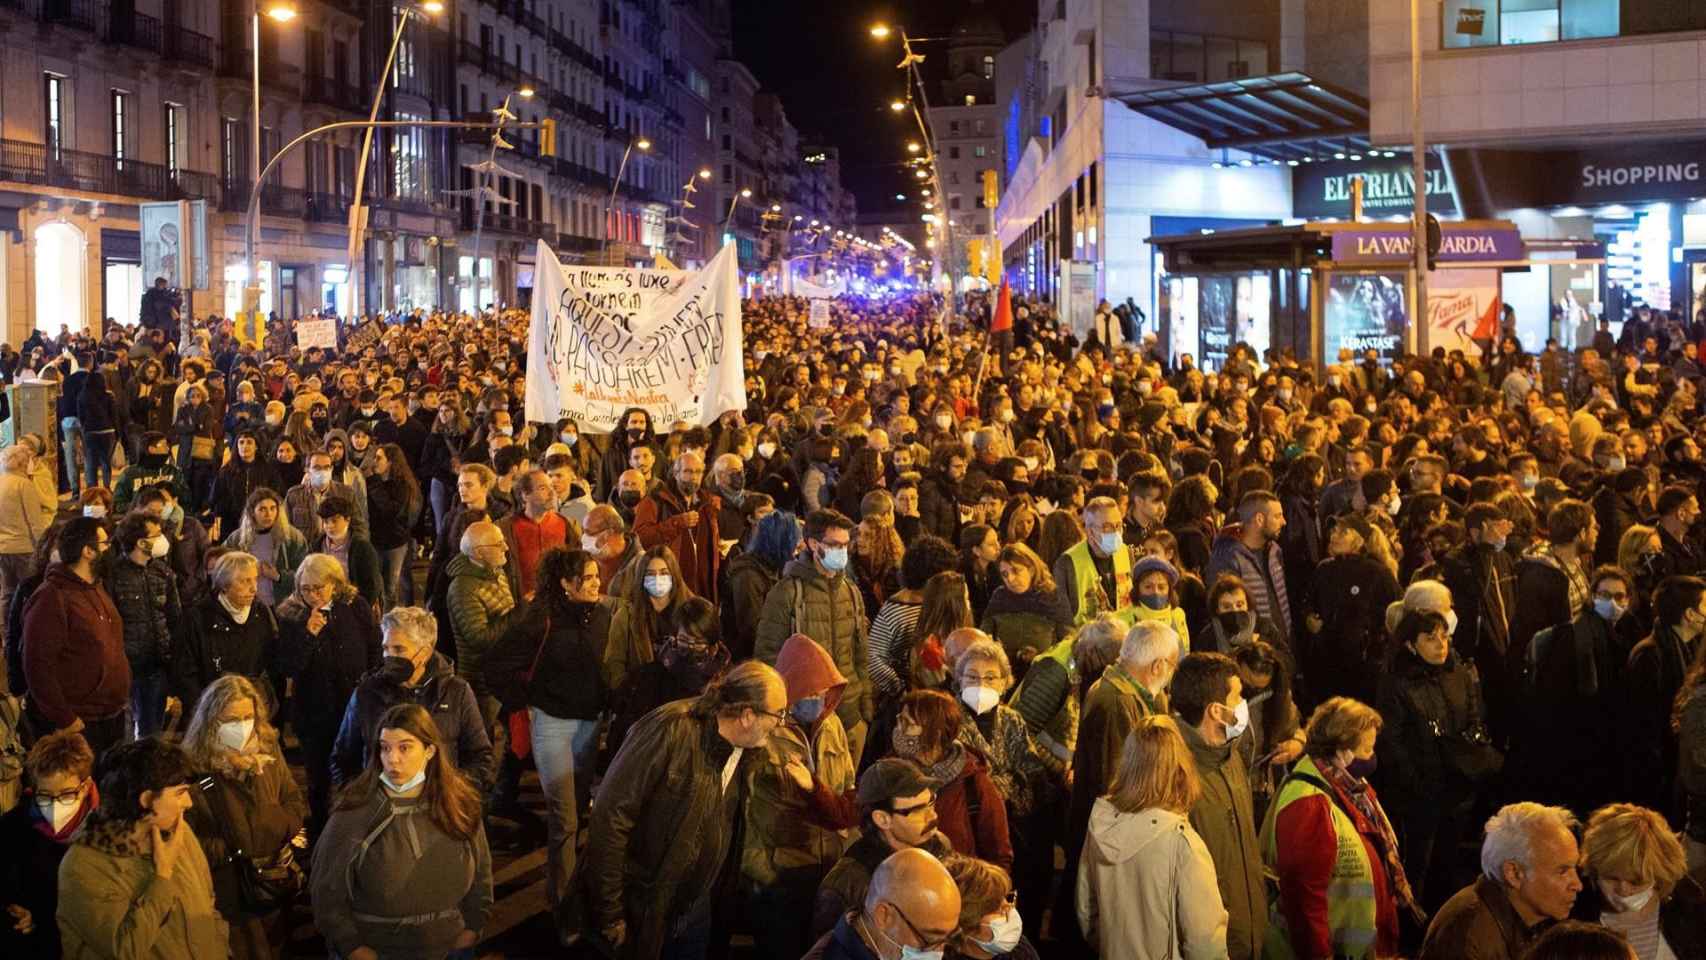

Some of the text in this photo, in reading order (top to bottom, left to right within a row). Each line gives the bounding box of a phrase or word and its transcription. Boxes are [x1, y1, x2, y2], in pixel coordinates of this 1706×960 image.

[1583, 163, 1699, 187] SHOPPING
[1324, 176, 1349, 201] EL
[1358, 236, 1497, 254] LA VANARDIA
[639, 272, 670, 289] luxe
